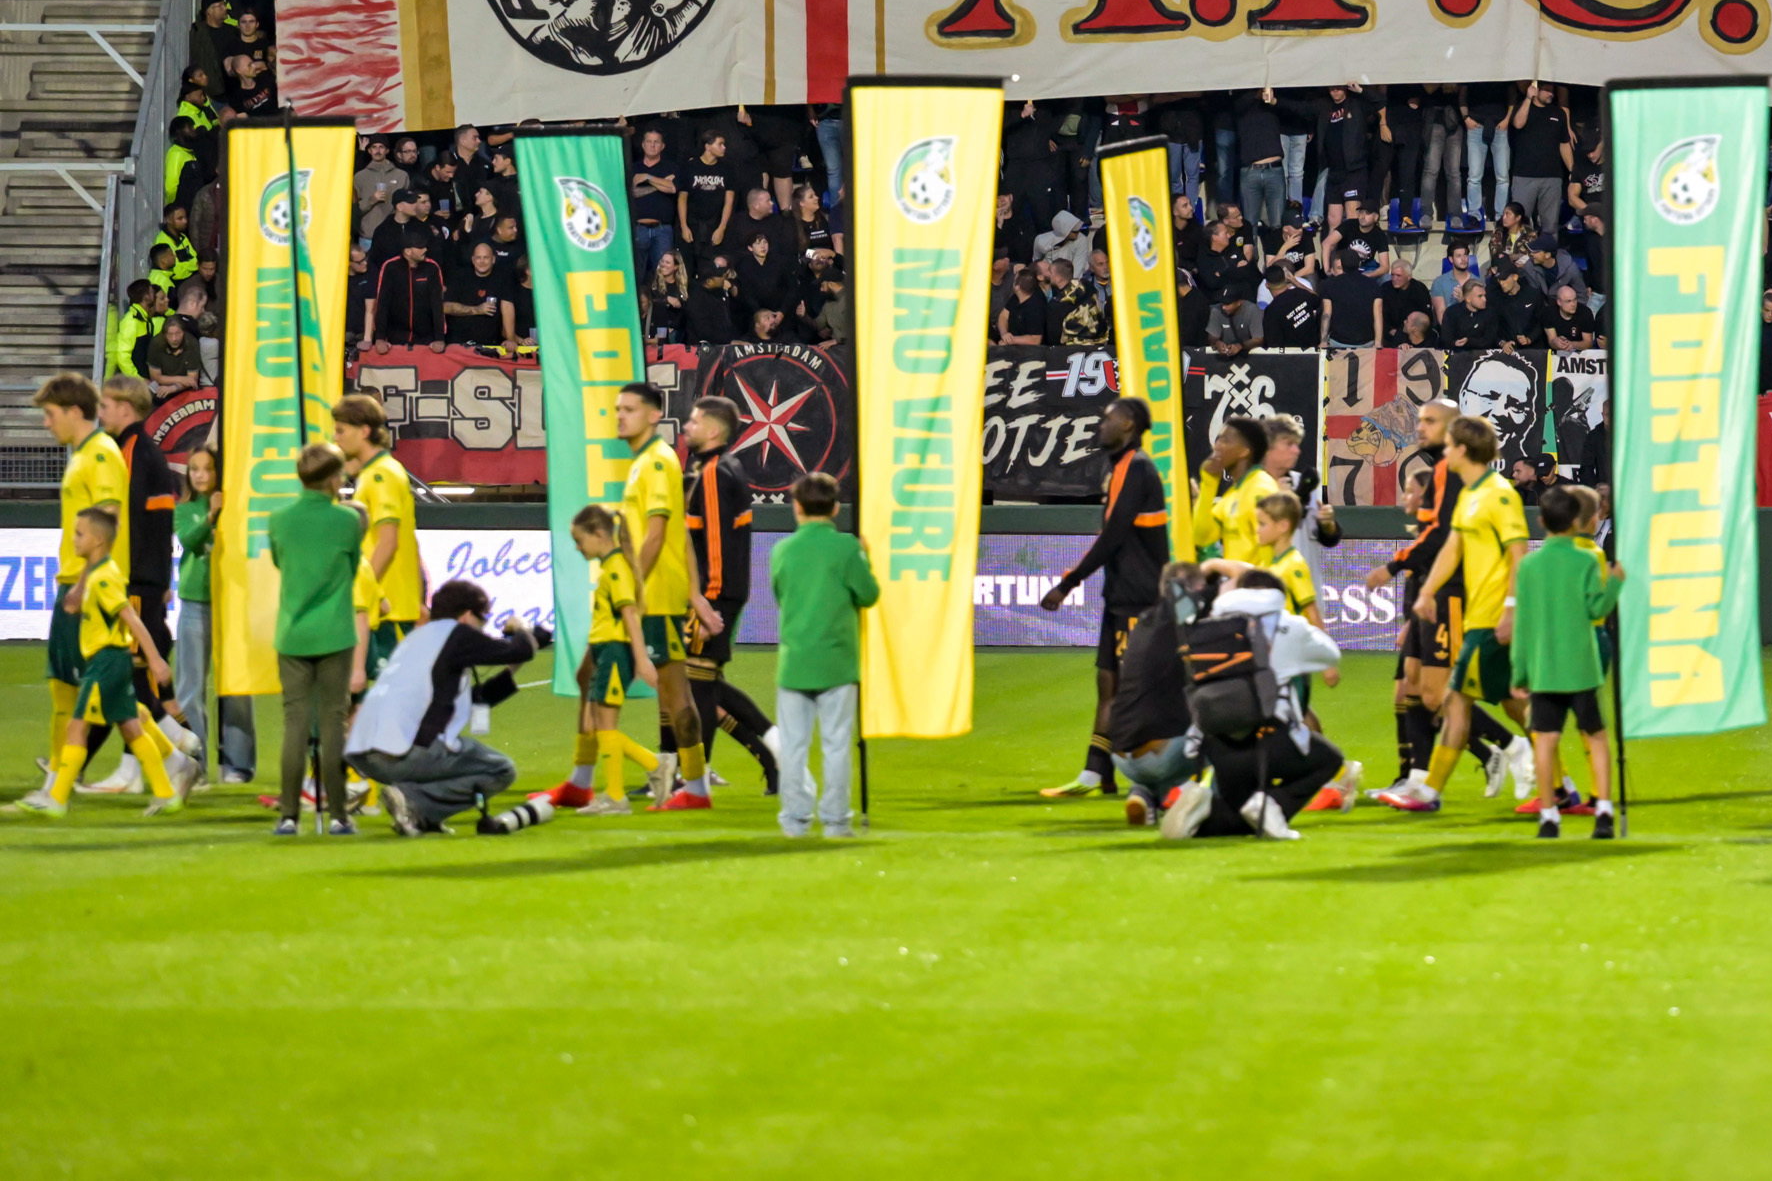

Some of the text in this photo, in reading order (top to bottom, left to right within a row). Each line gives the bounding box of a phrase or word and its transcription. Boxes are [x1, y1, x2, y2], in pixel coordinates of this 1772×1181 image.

[893, 248, 962, 374] NAO
[153, 399, 216, 446] MSTERDAM
[888, 395, 956, 582] VEURE
[1648, 245, 1725, 707] FORTUNA
[447, 539, 552, 581] Jobce
[973, 575, 1085, 606] RTUNA
[1435, 623, 1449, 649] 4
